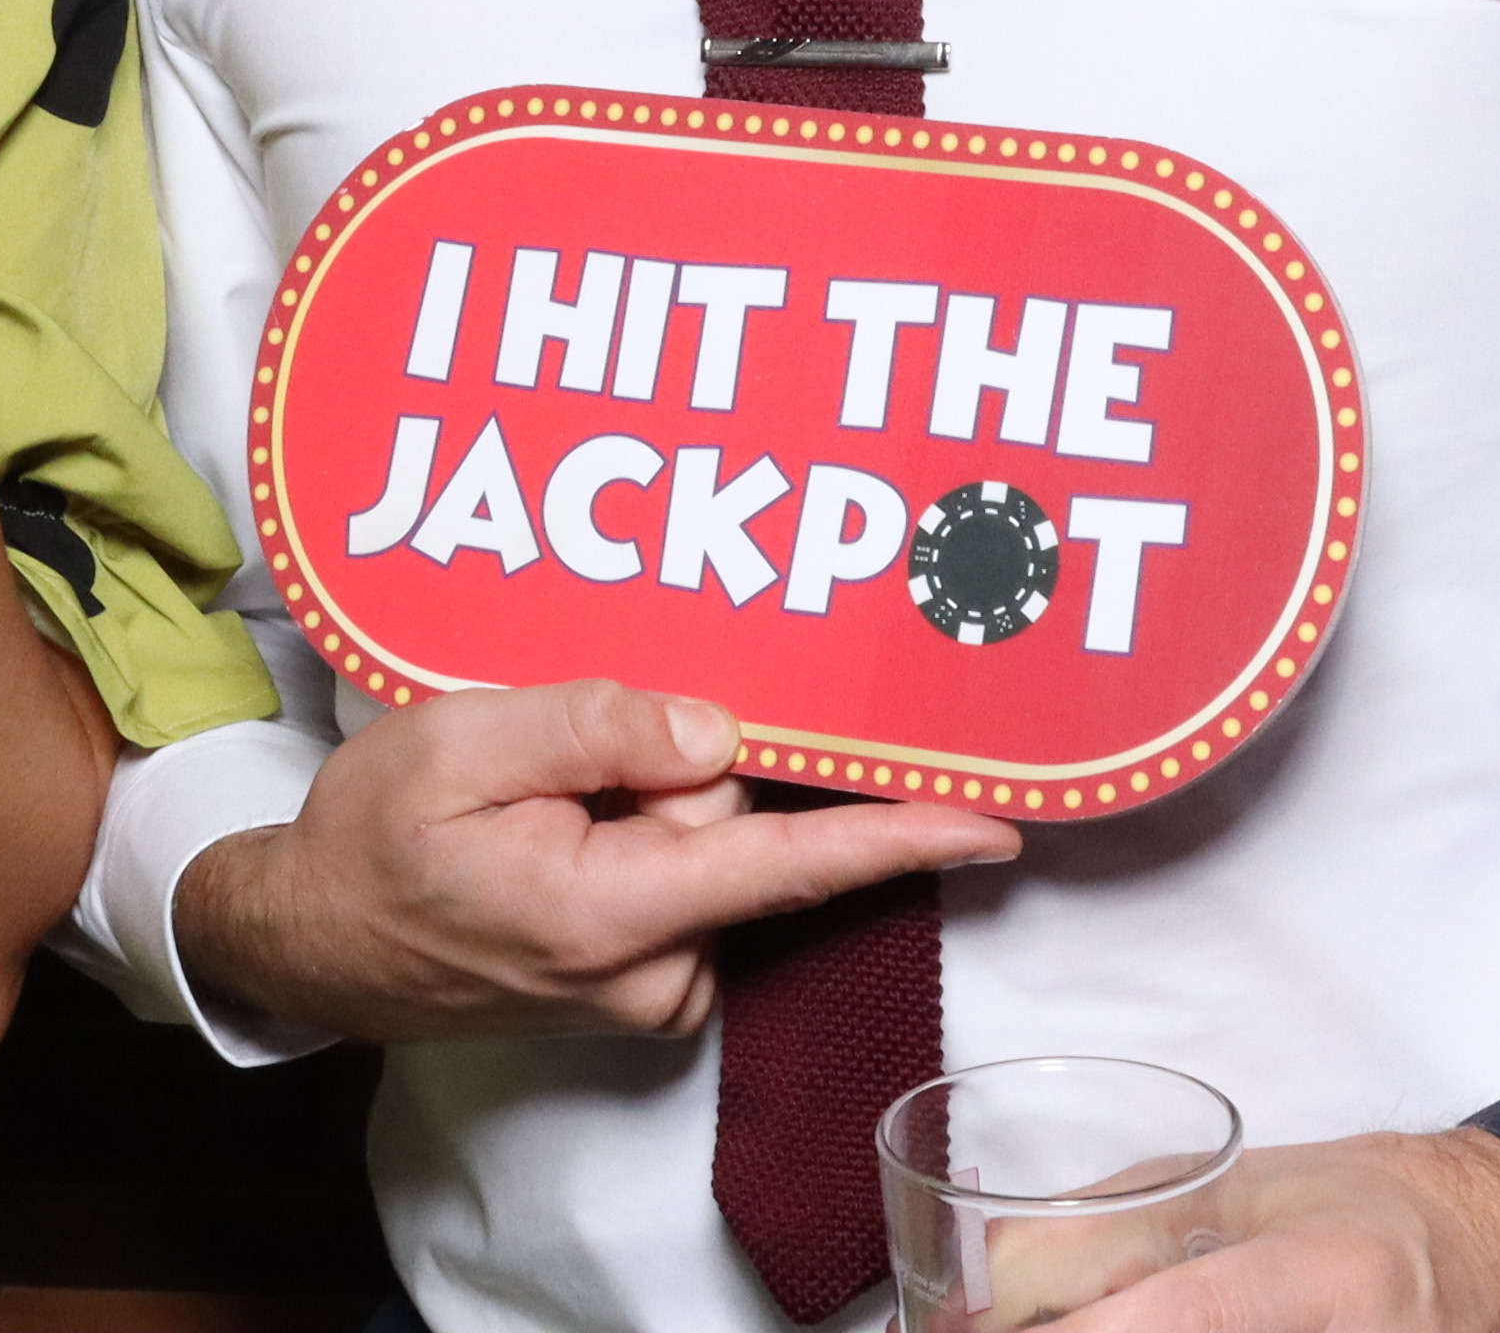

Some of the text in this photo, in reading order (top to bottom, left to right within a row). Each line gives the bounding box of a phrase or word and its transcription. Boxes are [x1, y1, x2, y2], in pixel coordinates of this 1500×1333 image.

[403, 238, 1176, 466] I HIT THE
[345, 413, 1190, 656] JACKPOT
